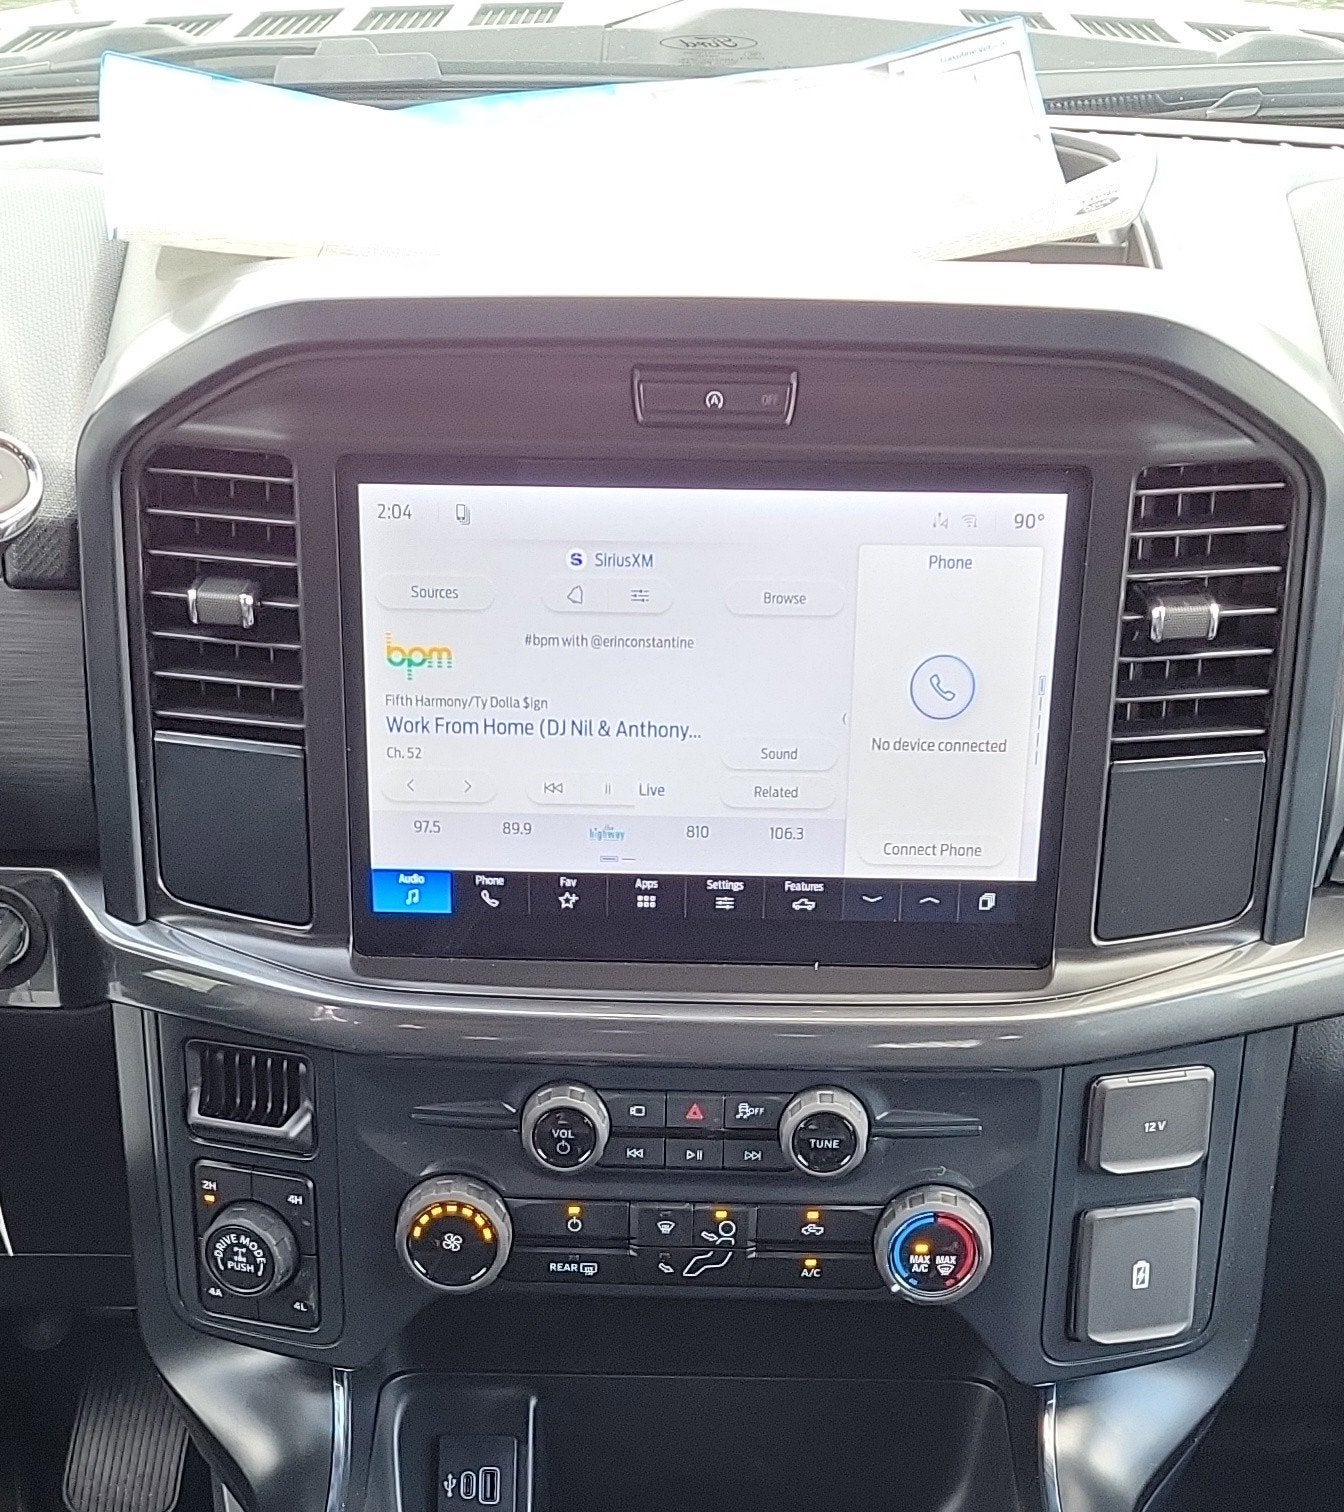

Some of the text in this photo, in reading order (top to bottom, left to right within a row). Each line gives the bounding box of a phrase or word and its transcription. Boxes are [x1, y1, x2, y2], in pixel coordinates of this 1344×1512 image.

[377, 503, 412, 519] 2:04
[594, 553, 654, 567] SiriusXM
[928, 555, 972, 570] Phone
[411, 585, 458, 599] Sources
[763, 592, 806, 605] Browse
[525, 634, 694, 649] #bpm with @erinconstantine
[386, 632, 453, 681] bpm
[385, 695, 548, 711] Fifth Harmony/Ty Dolla $ign
[386, 717, 701, 741] Work From Home (DJ Nil & Anthony...
[871, 738, 1007, 753] No device connected
[386, 747, 422, 760] Ch. 52
[760, 747, 798, 760] Sound
[639, 783, 665, 796] Live
[754, 786, 799, 799] Related
[413, 820, 441, 834] 97.5
[502, 821, 532, 835] 89.9
[686, 825, 709, 838] 810
[769, 826, 804, 840] 106.3
[883, 843, 981, 857] Connect Phone
[398, 873, 425, 885] Audio
[475, 875, 504, 886] Phone
[560, 877, 577, 888] Fav
[635, 877, 658, 890] Apps
[706, 880, 744, 892] Settings
[784, 881, 824, 893] Features
[749, 1107, 765, 1116] OFF
[1144, 1121, 1156, 1133] 12
[552, 1129, 574, 1139] VOL
[809, 1138, 840, 1149] TUNE
[201, 1180, 217, 1191] 2H
[287, 1195, 303, 1206] 4H
[213, 1233, 266, 1265] DRIVE MODE
[909, 1255, 930, 1264] MAX
[935, 1256, 957, 1265] MAX
[227, 1260, 254, 1273] PUSH
[549, 1263, 578, 1272] REAR
[801, 1268, 821, 1277] A/C
[911, 1264, 929, 1273] A/C
[208, 1287, 223, 1298] 4A
[293, 1301, 308, 1312] 4L
